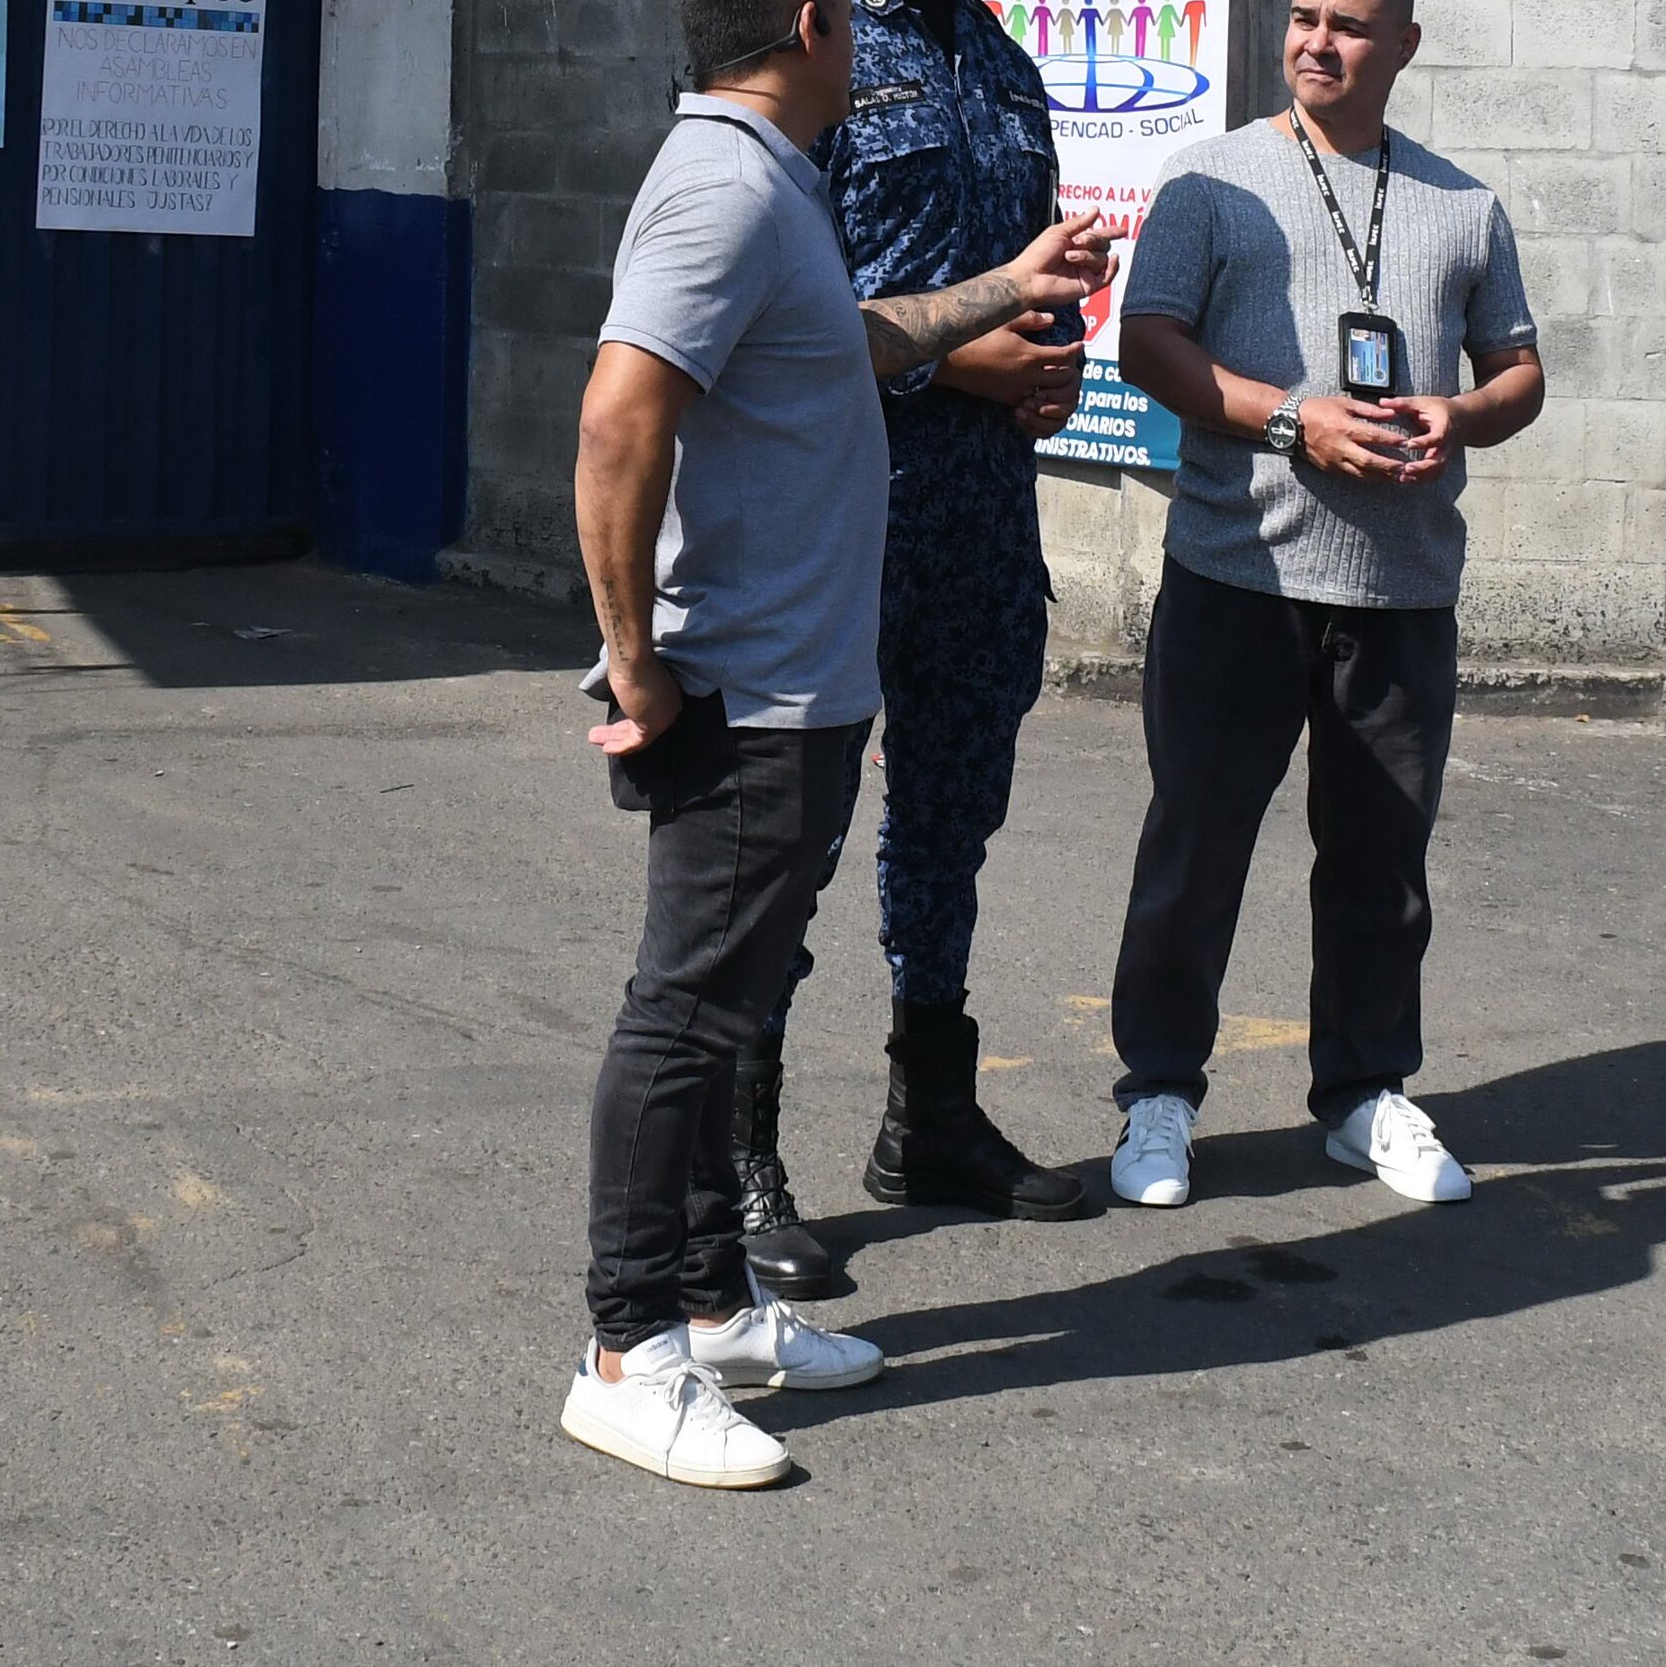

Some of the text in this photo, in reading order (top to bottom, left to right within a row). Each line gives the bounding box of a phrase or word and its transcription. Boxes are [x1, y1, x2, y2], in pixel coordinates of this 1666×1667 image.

[57, 26, 258, 61] NOS DECLARAMOS EN
[100, 55, 213, 84] ASAMBLEAS
[76, 80, 228, 110] INFORMATIVAS
[1140, 107, 1205, 138] SOCIAL
[227, 173, 240, 191] Y
[1058, 184, 1103, 201] RECHO
[1105, 187, 1116, 202] A
[1120, 187, 1137, 203] LA
[1083, 360, 1103, 380] de
[1084, 390, 1123, 412] para
[1122, 391, 1149, 412] los
[1066, 412, 1137, 438] ONARIOS
